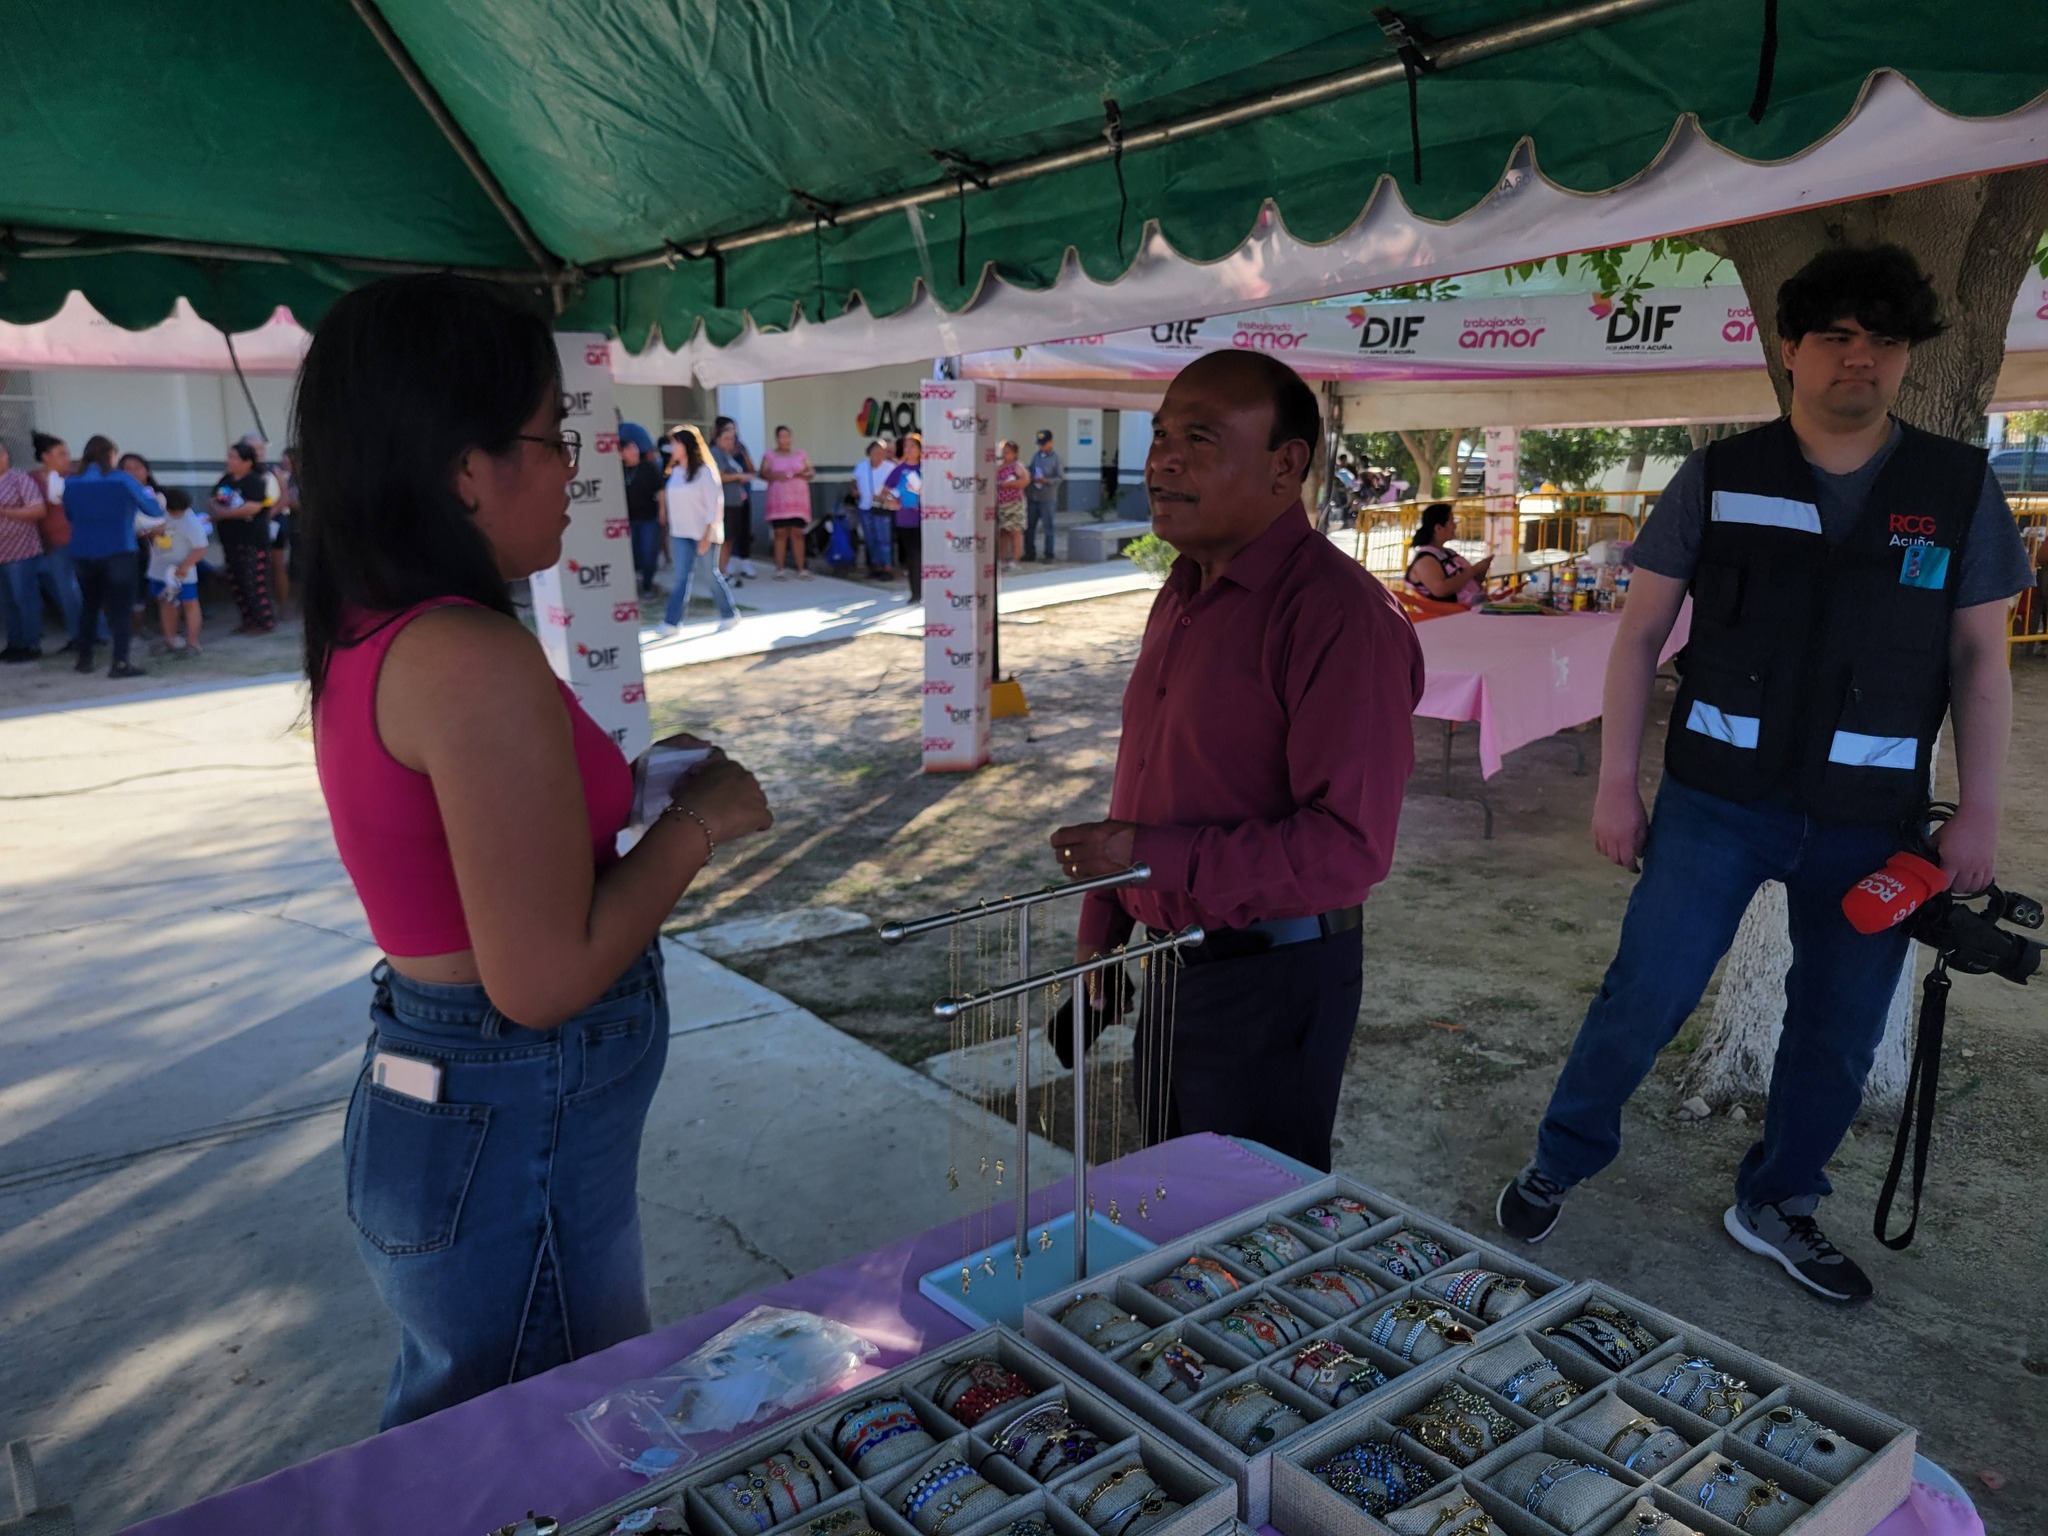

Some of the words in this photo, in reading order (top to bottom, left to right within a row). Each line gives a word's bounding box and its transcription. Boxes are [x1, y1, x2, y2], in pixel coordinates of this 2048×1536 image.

[1359, 316, 1425, 348] DIF
[1463, 316, 1526, 329] trabajando
[1606, 305, 1682, 344] DIF
[1232, 331, 1308, 350] amor
[1458, 327, 1545, 348] amor
[1646, 343, 1673, 351] ACUÑA
[569, 479, 603, 500] DIF
[1889, 513, 1937, 535] RCG
[578, 563, 612, 586] DIF
[587, 646, 620, 669] DIF
[1857, 879, 1898, 903] RCG
